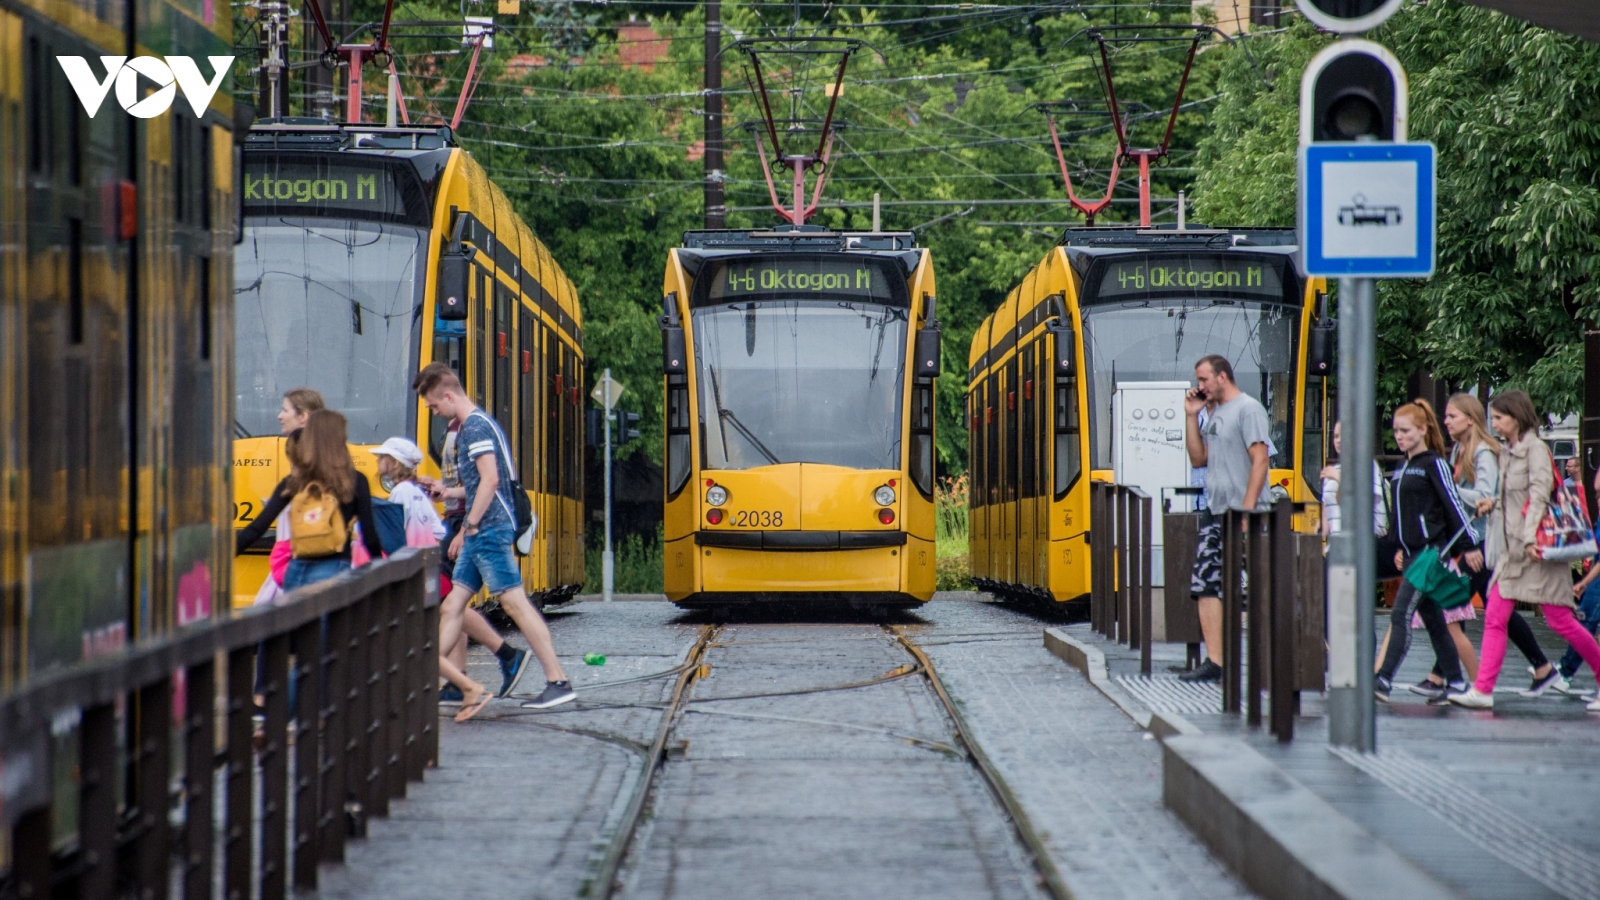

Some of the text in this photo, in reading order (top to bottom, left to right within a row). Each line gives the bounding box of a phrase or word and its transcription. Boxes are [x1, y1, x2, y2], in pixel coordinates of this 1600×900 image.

[357, 173, 375, 200] M
[728, 268, 870, 291] 4-6 Oktogon M
[1118, 266, 1262, 289] 4-6 Oktogon M
[737, 510, 783, 528] 2038
